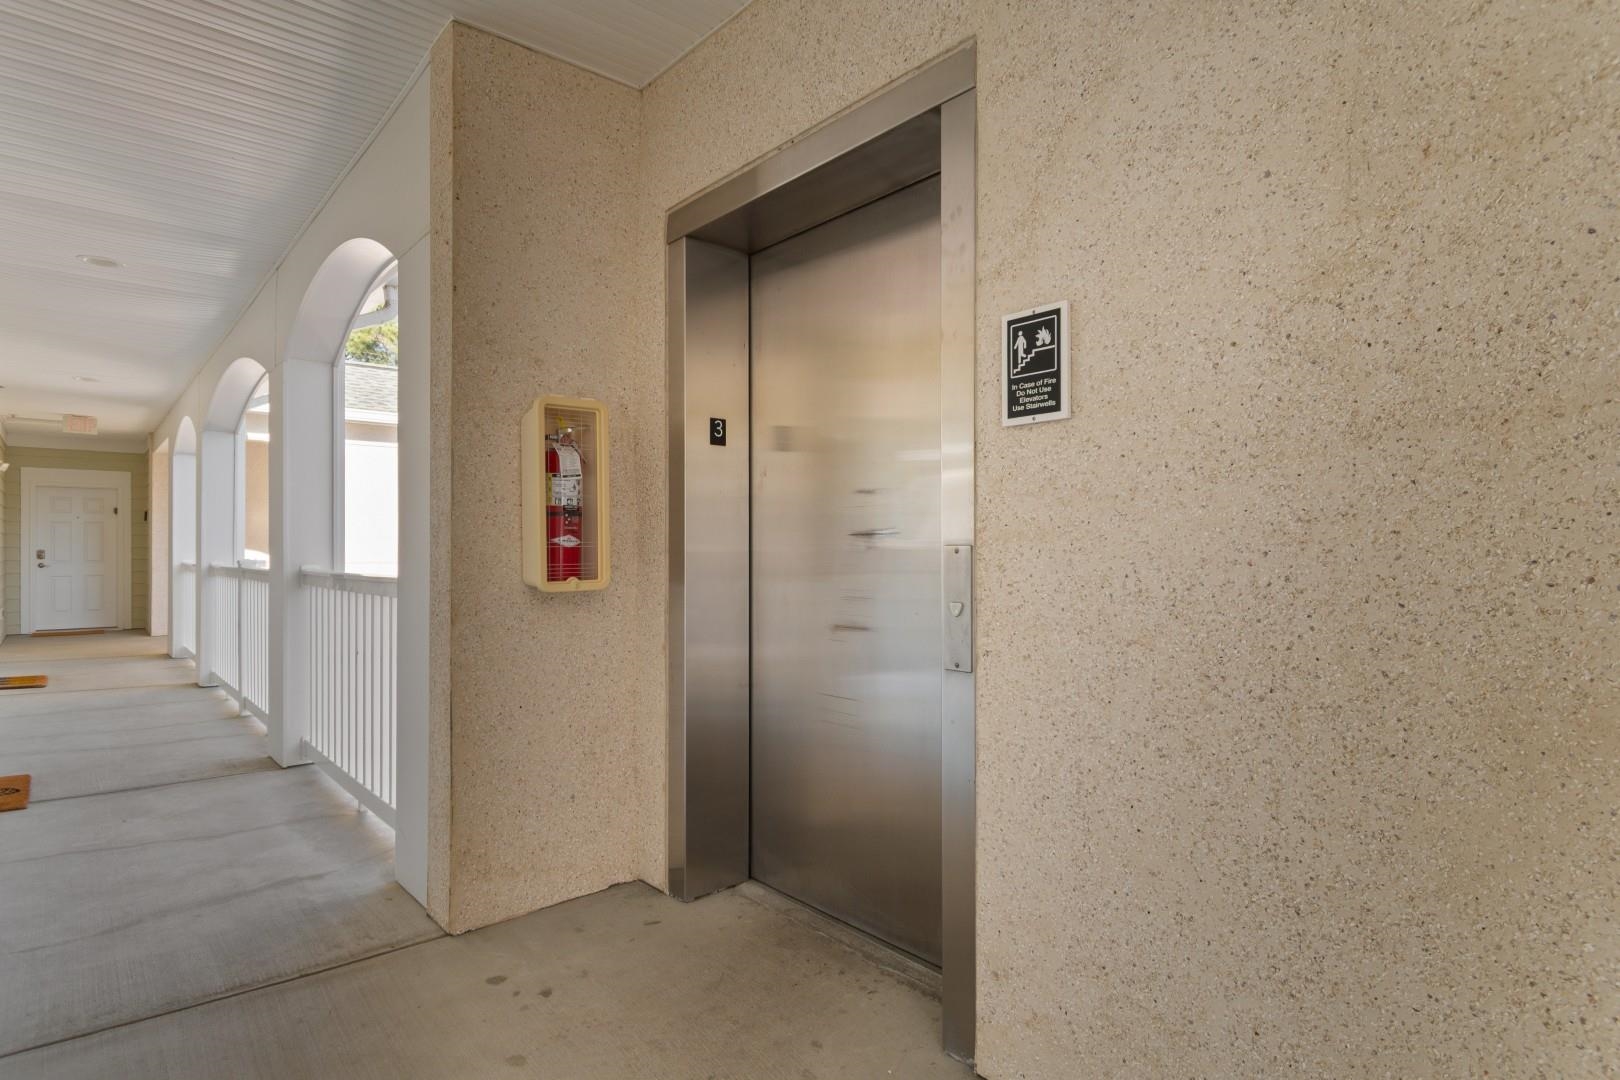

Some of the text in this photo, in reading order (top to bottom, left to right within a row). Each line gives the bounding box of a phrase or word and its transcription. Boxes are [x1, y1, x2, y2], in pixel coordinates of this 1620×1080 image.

[1019, 394, 1048, 403] Elevators
[1025, 400, 1056, 409] Stairwells
[714, 420, 723, 437] 3
